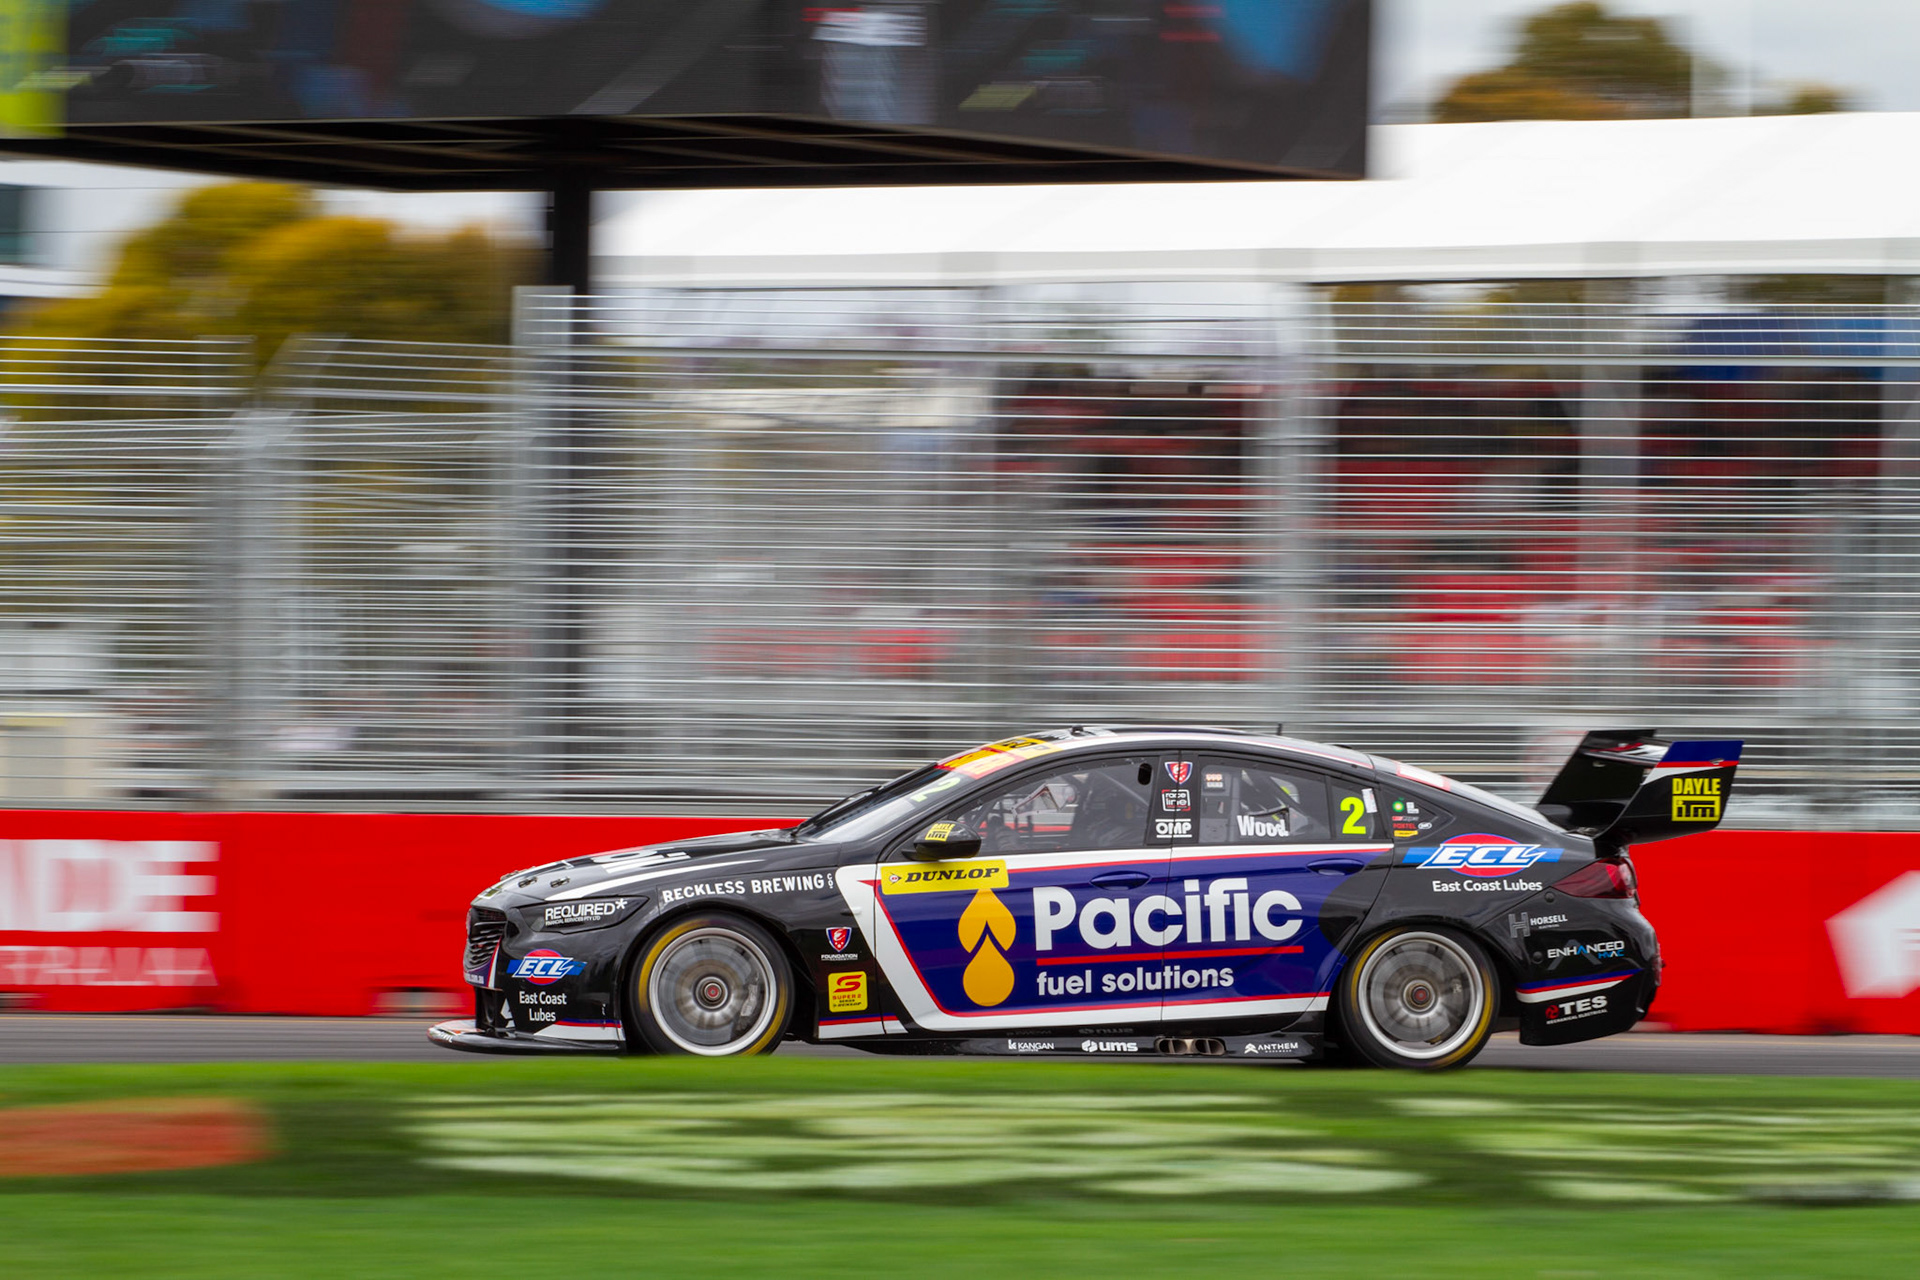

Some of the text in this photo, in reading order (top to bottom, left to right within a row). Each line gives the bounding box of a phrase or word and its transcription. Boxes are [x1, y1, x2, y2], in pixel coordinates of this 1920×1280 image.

[1672, 778, 1721, 795] DAYLE
[1340, 796, 1366, 834] 2
[1156, 822, 1192, 835] OMP
[904, 866, 1000, 884] DUNLOP
[662, 881, 745, 903] RECKLESS
[751, 873, 825, 894] BREWING
[1432, 878, 1543, 892] East Coast Lubes
[1034, 878, 1303, 951] Pacific
[1530, 914, 1568, 926] HORSELL
[1547, 940, 1625, 959] ENHANCED
[1598, 949, 1625, 960] HVAC
[1037, 964, 1234, 996] fuel solutions
[519, 991, 567, 1005] East Coast
[1559, 995, 1608, 1016] TES
[529, 1008, 556, 1021] Lubes
[1018, 1042, 1055, 1050] KANGAN
[1099, 1041, 1138, 1052] ums
[1258, 1042, 1298, 1051] ANTHEM
